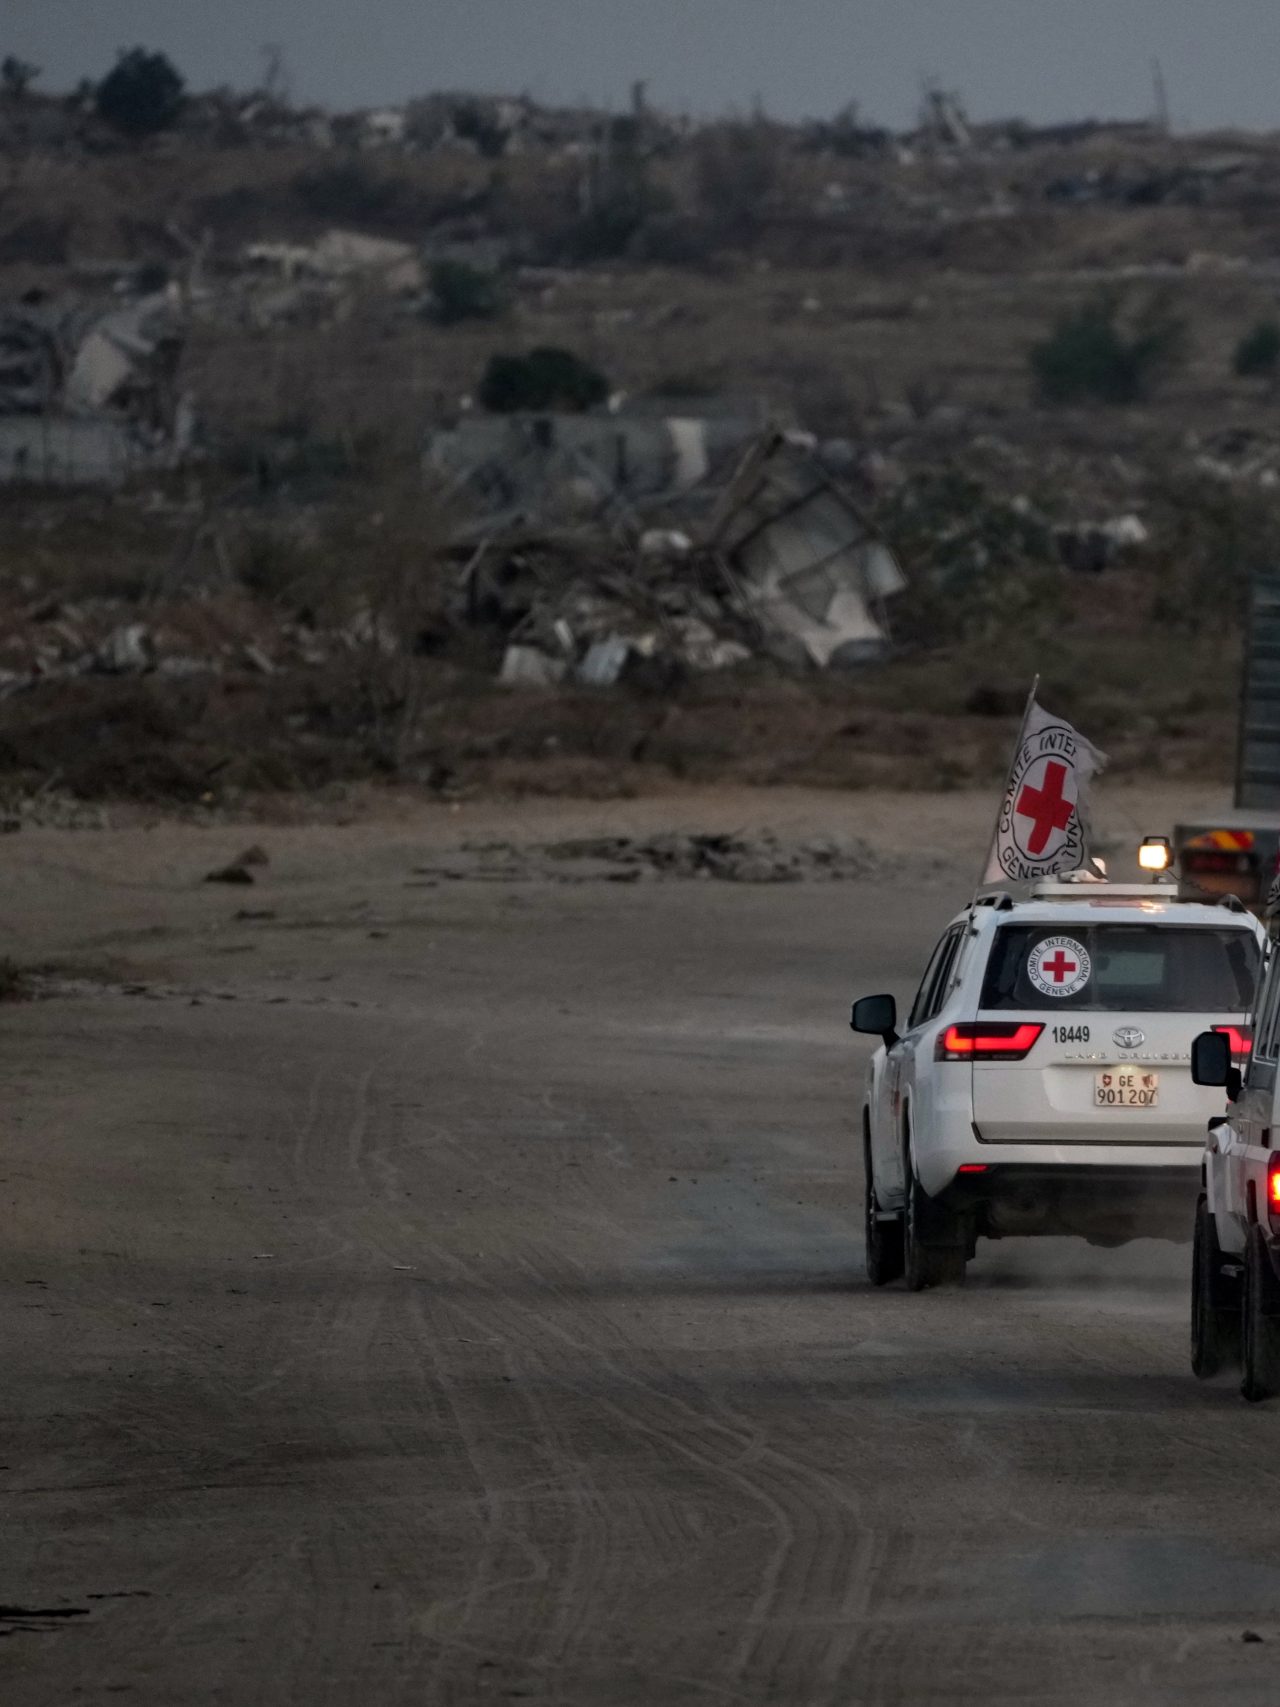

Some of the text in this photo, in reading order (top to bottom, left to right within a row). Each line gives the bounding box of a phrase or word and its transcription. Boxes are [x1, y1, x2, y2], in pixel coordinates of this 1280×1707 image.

[1001, 746, 1031, 833] COMITE
[1029, 938, 1089, 982] COMITE INTERNATIONAL
[1039, 983, 1077, 995] GENEVE
[1052, 1026, 1090, 1043] 18449
[1119, 1075, 1134, 1087] GE
[1098, 1089, 1156, 1104] 901 207
